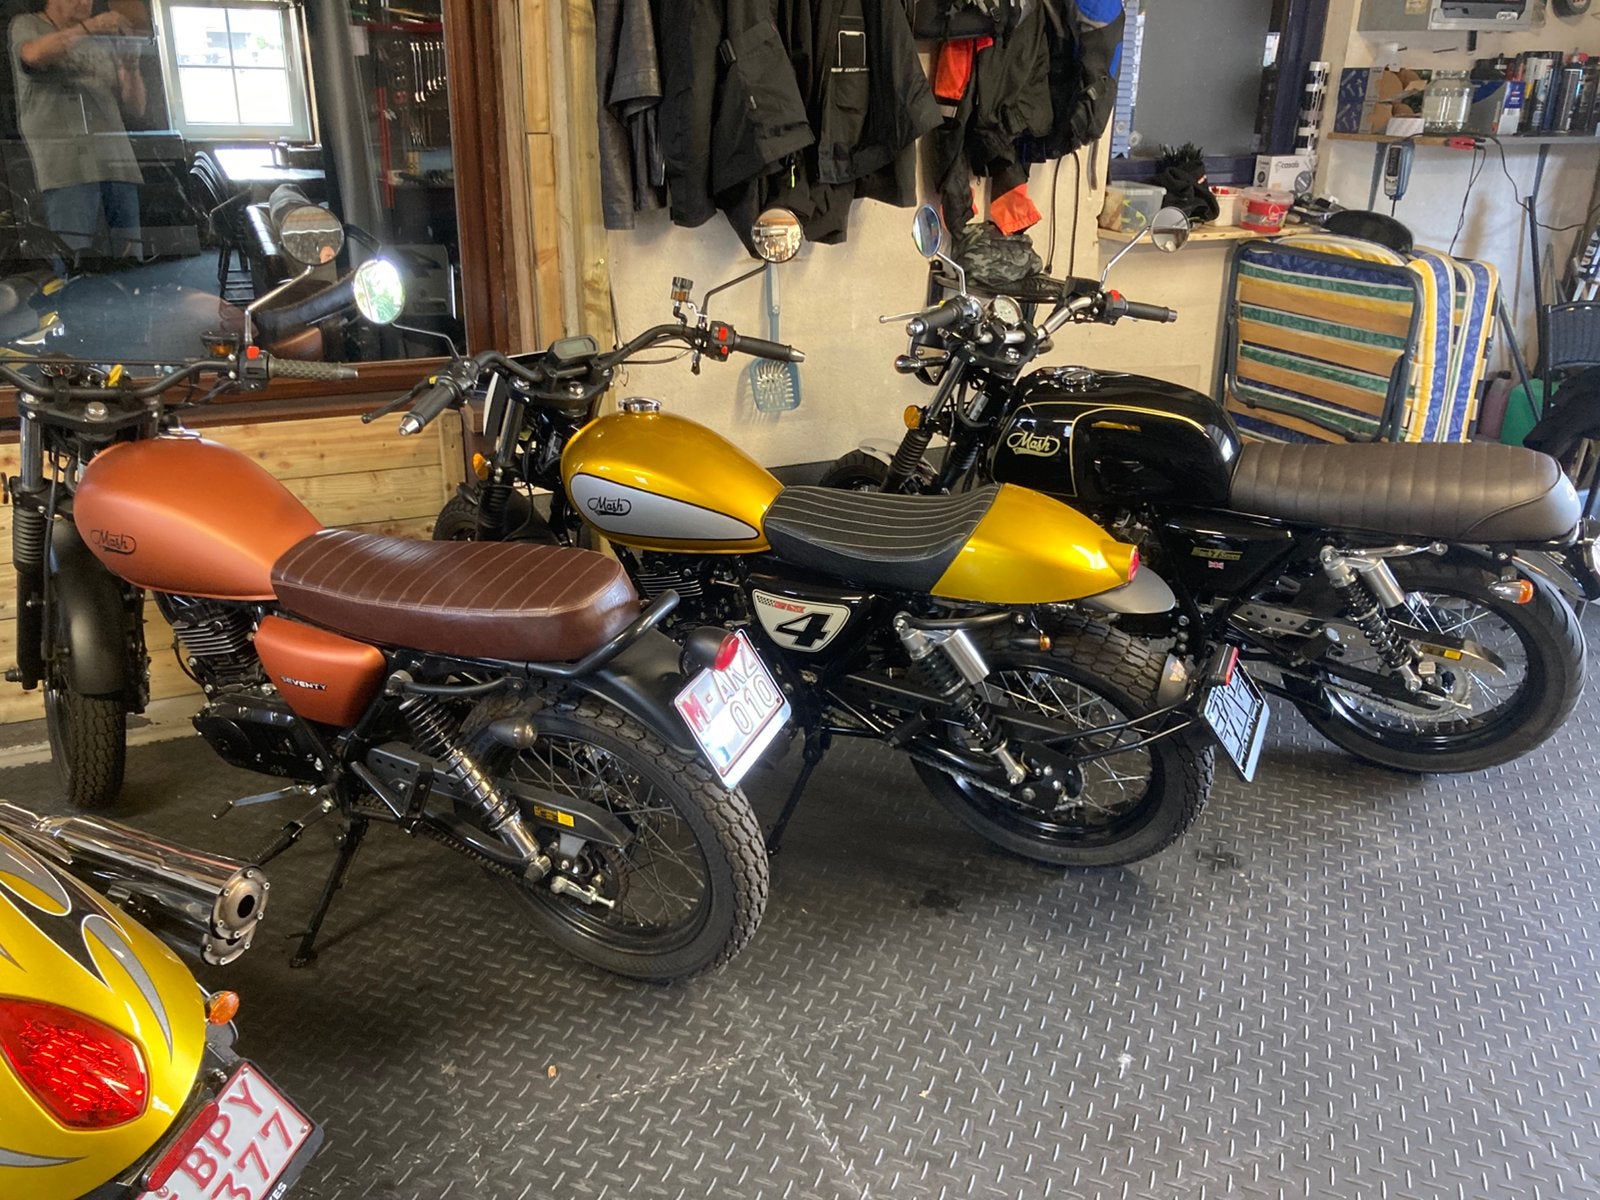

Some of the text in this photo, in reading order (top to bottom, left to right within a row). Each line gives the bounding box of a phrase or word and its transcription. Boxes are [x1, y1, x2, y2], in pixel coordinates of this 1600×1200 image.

[1007, 432, 1050, 452] Mash
[588, 497, 624, 513] Mash
[90, 529, 128, 551] Mash
[774, 612, 833, 648] 4
[281, 676, 327, 690] SEVENTY
[729, 673, 776, 735] 010
[178, 1077, 263, 1190] BPY
[210, 1109, 293, 1200] 377
